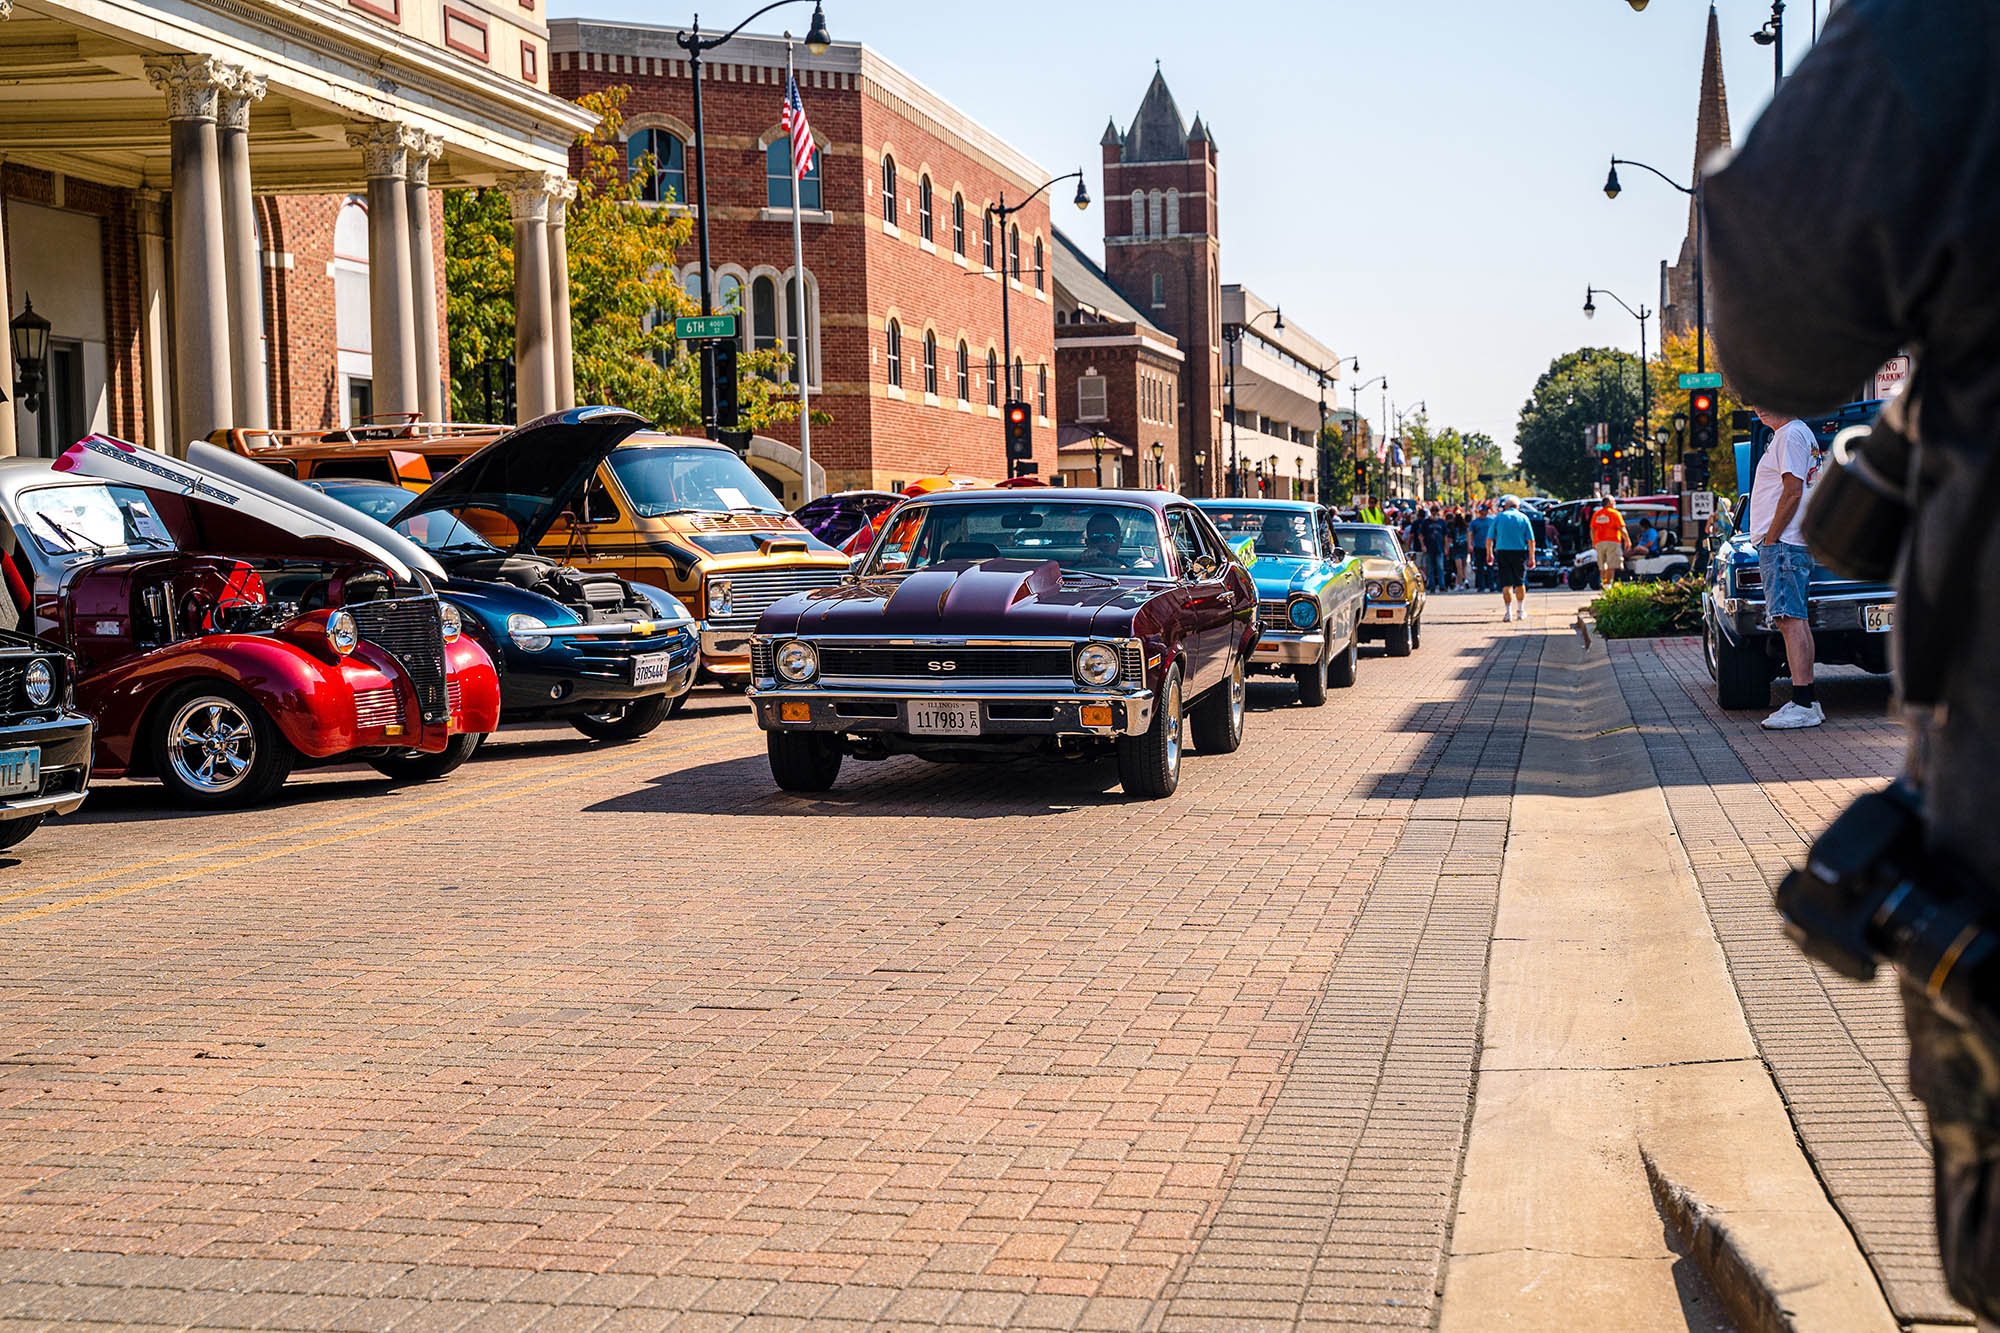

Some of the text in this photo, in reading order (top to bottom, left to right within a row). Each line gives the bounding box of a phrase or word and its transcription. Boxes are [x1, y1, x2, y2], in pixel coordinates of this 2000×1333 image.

[686, 321, 705, 333] 6TH
[1885, 362, 1898, 372] NO
[1869, 612, 1881, 626] 66
[927, 660, 957, 671] SS
[917, 711, 965, 728] 117983
[29, 762, 37, 784] 1
